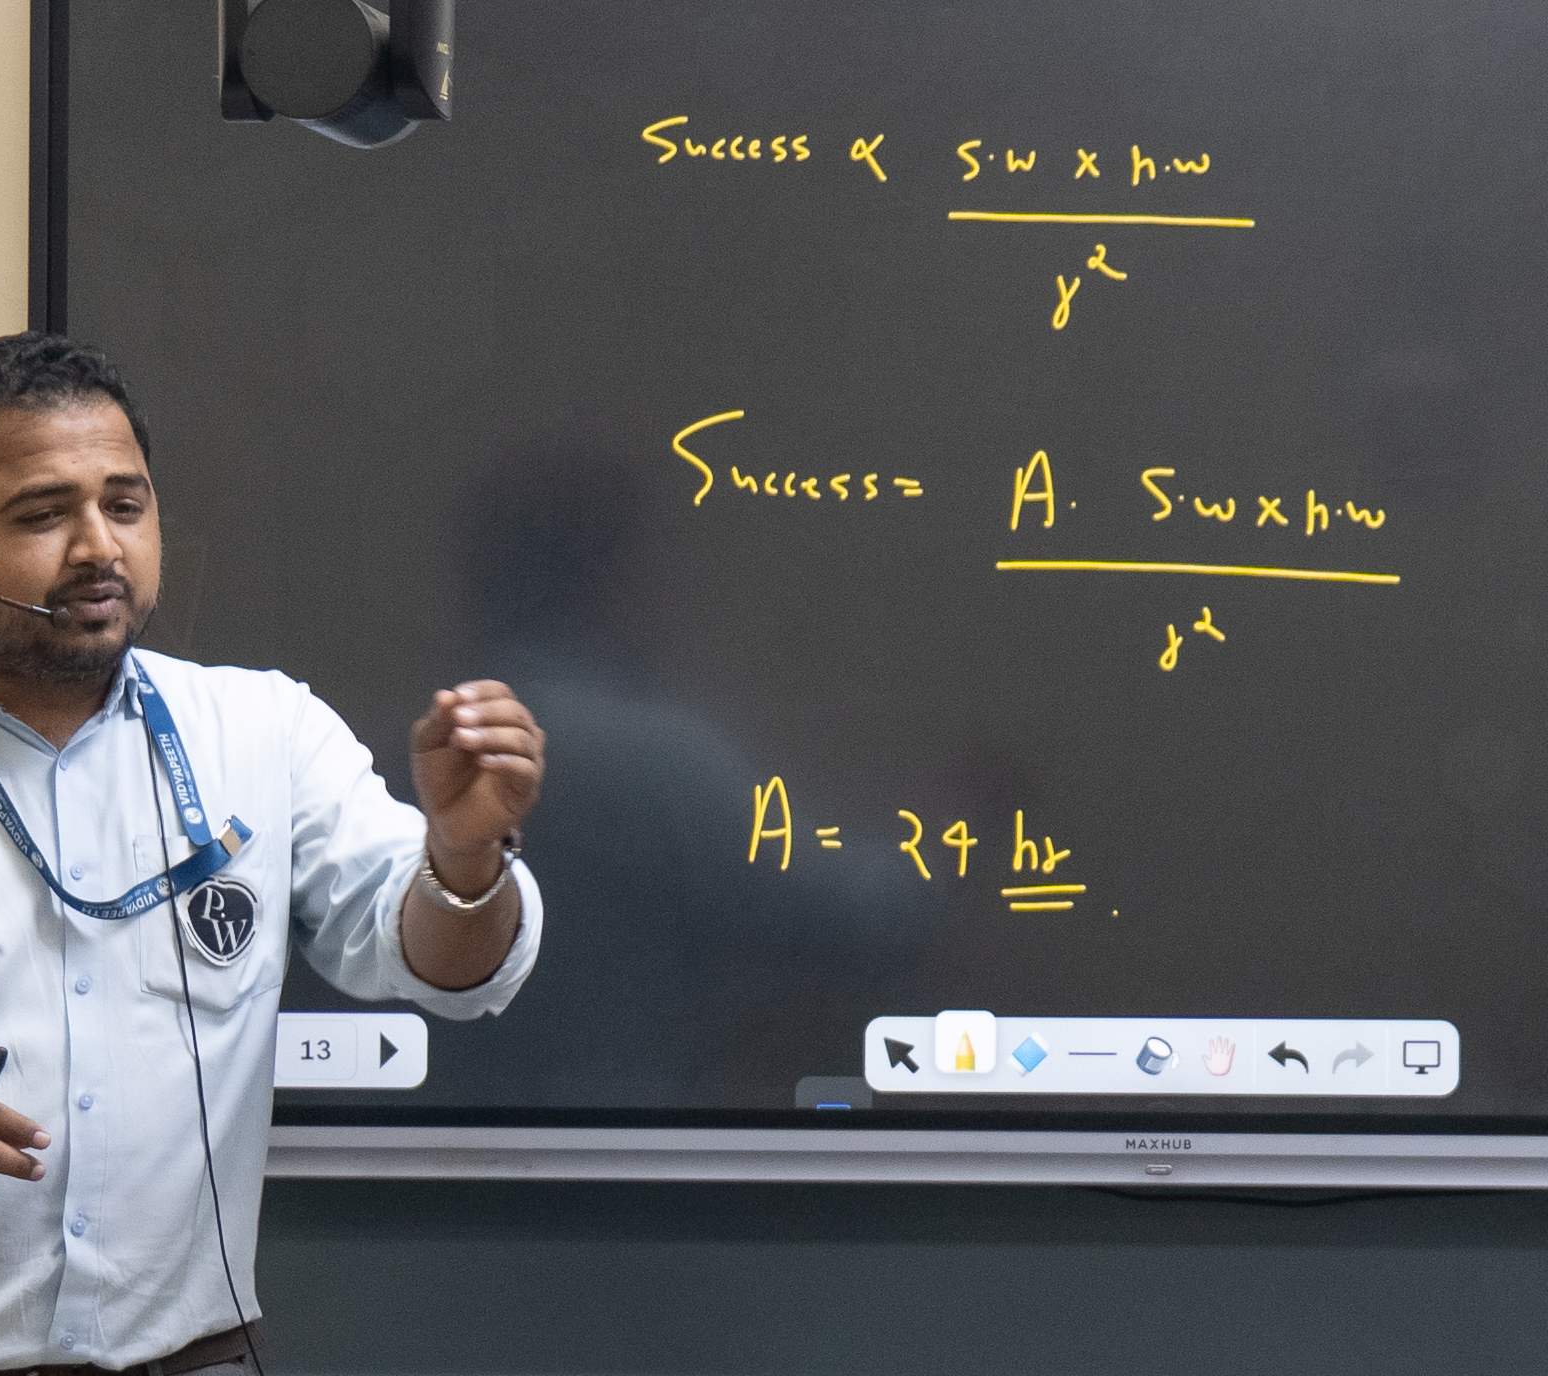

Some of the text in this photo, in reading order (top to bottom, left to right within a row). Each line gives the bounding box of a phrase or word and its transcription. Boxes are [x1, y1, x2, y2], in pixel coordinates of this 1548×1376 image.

[642, 116, 810, 164] Success
[898, 810, 978, 880] 24
[301, 1040, 330, 1060] 13
[1126, 1139, 1191, 1150] MAXHUB
